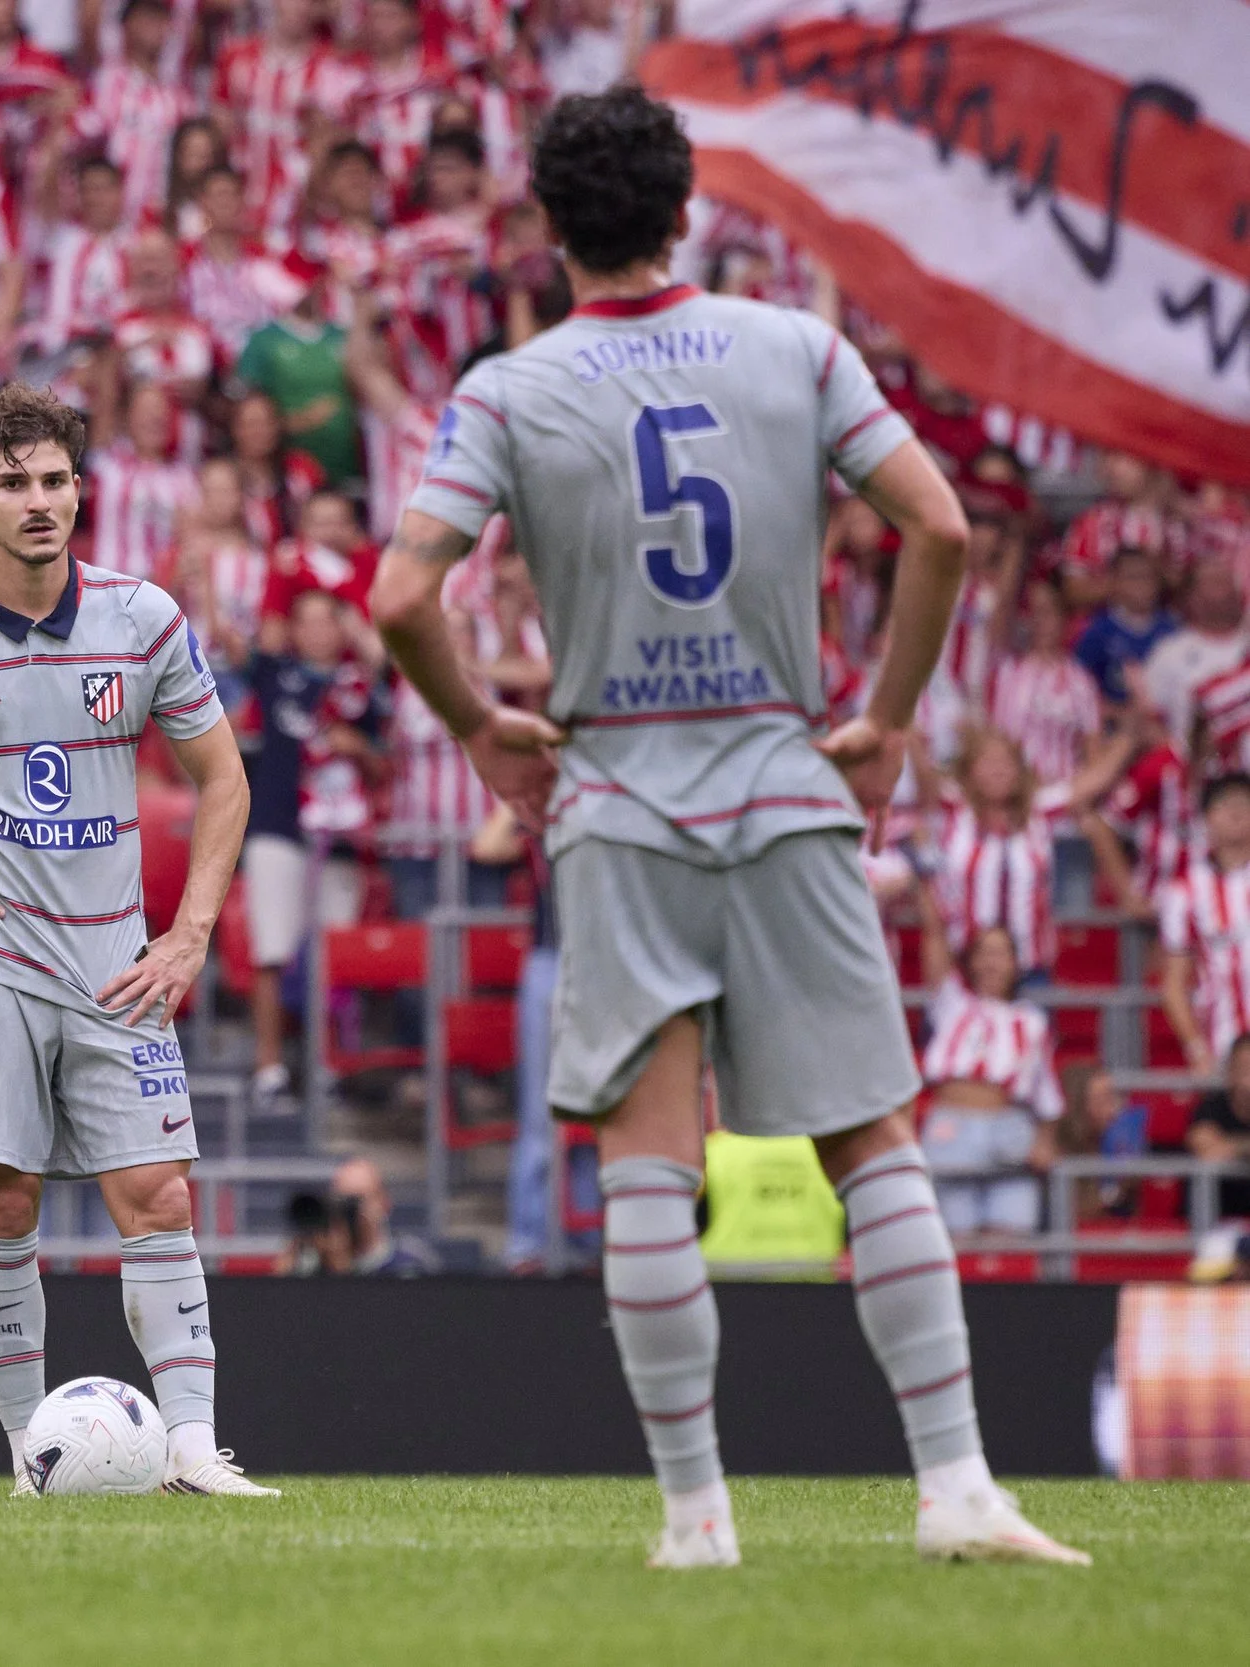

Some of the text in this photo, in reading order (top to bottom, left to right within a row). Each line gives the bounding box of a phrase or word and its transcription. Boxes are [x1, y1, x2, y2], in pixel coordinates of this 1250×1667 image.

[574, 330, 733, 384] JOHNNY
[633, 400, 735, 607] 5
[637, 632, 735, 670] VISIT
[604, 668, 769, 708] RWANDA
[80, 820, 114, 845] AIR
